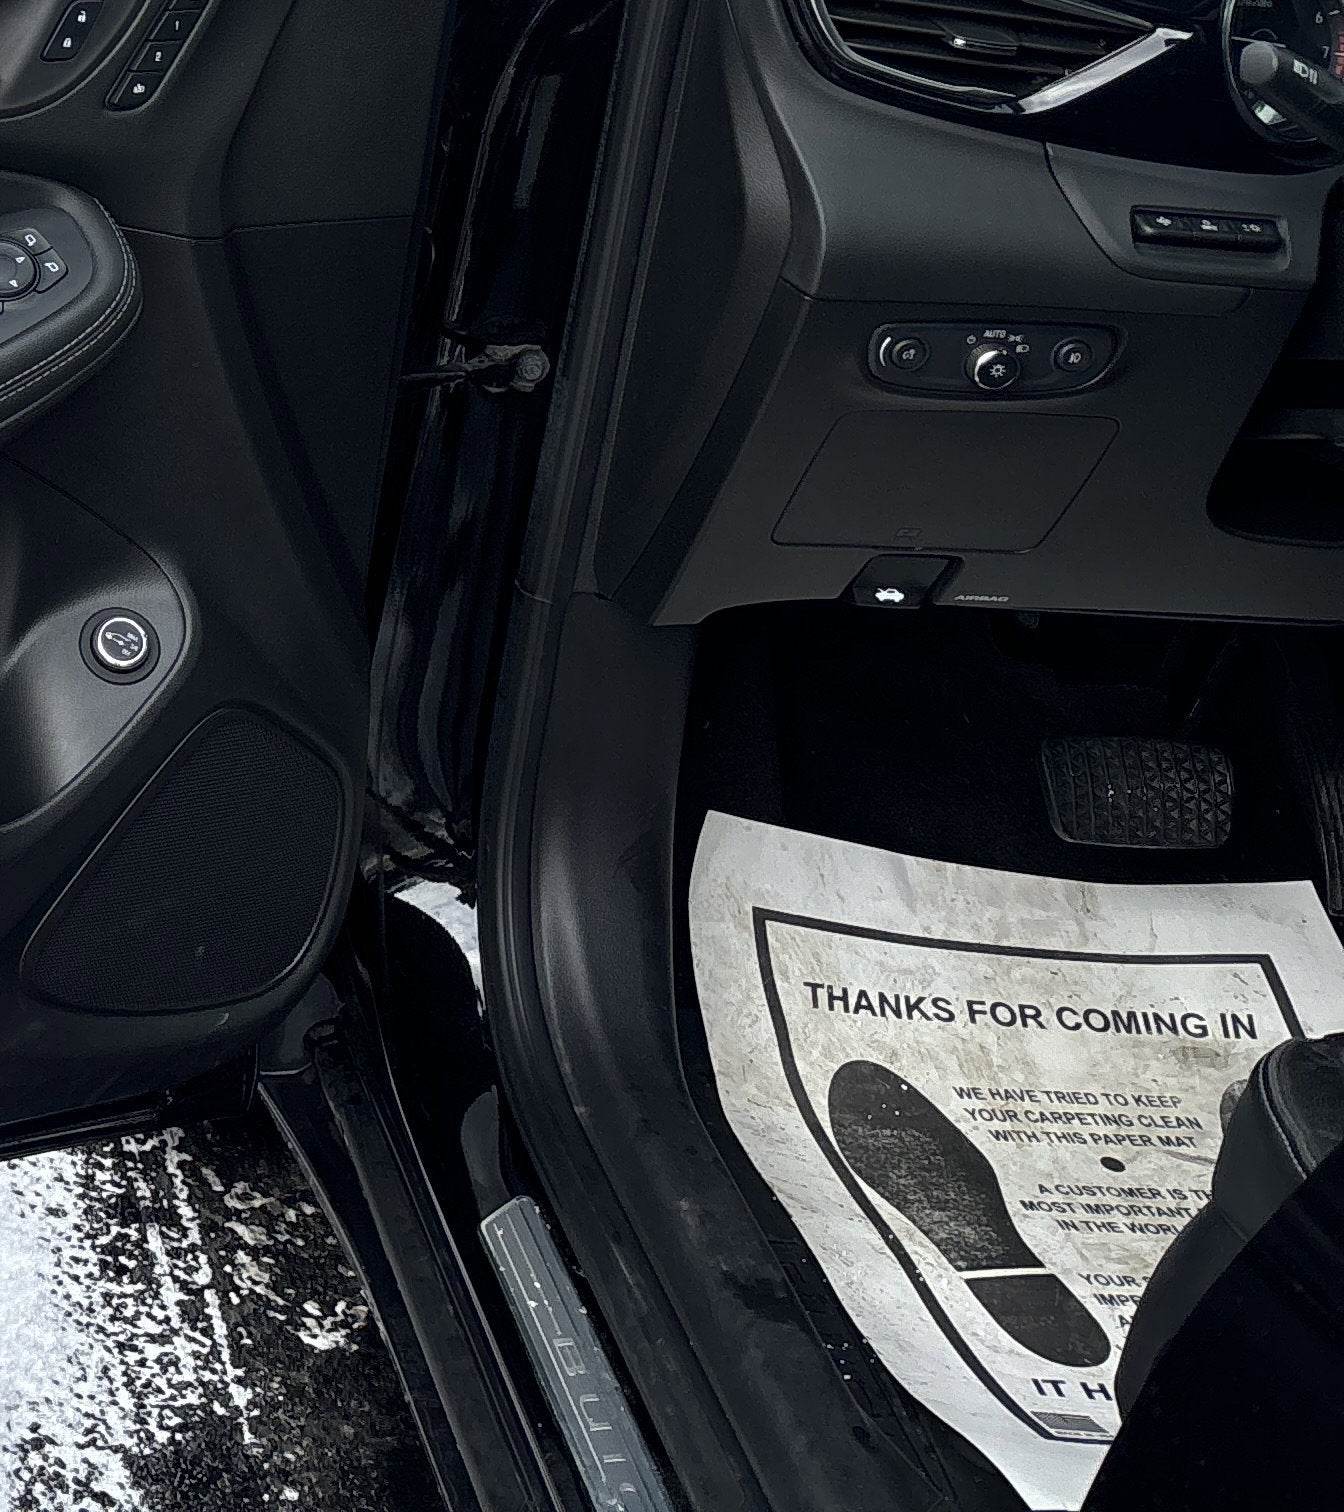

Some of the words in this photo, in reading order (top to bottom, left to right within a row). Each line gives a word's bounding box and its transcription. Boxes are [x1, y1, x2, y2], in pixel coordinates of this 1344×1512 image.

[1315, 11, 1324, 25] 6
[1321, 45, 1330, 60] 7
[983, 330, 1007, 339] AUTO
[803, 981, 955, 1023] THANKS
[965, 999, 1046, 1030] FOR
[1056, 1006, 1208, 1038] COMING
[1219, 1012, 1259, 1039] IN
[952, 1086, 987, 1101] WE
[988, 1087, 1041, 1103] HAVE
[1039, 1090, 1099, 1106] TRIED
[1101, 1092, 1129, 1107] TO
[1131, 1094, 1182, 1109] KEEP
[963, 1108, 1021, 1123] YOUR
[1024, 1109, 1135, 1127] CARPETING
[1137, 1114, 1203, 1130] CLEAN
[988, 1129, 1040, 1143] WITH
[1040, 1130, 1088, 1145] THIS
[1089, 1132, 1156, 1147] PAPER
[1155, 1135, 1197, 1148] MAT
[1038, 1183, 1052, 1196] A
[1055, 1184, 1166, 1200] CUSTOMER
[1166, 1188, 1188, 1201] IS
[1188, 1189, 1212, 1202] TH
[1019, 1200, 1079, 1214] MOST
[1080, 1202, 1194, 1219] IMPORTANT
[1055, 1219, 1080, 1232] IN
[1079, 1220, 1124, 1234] THE
[1078, 1273, 1142, 1288] YOUR
[1031, 1378, 1066, 1398] IT
